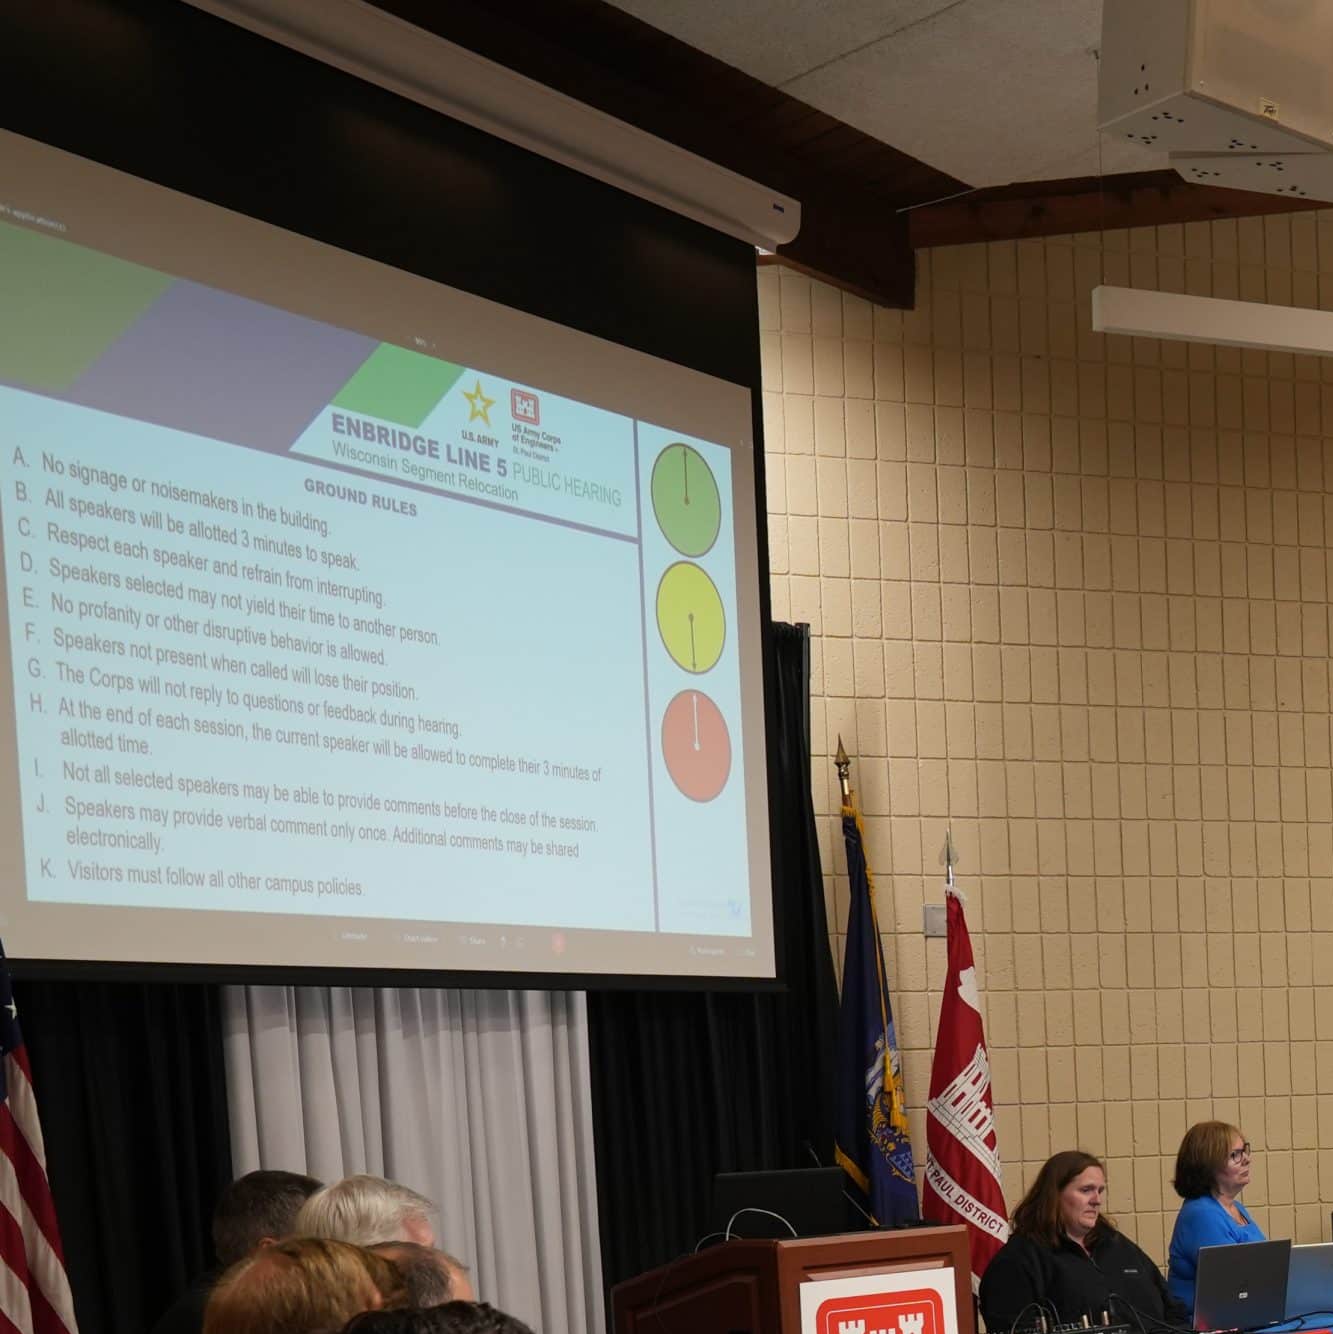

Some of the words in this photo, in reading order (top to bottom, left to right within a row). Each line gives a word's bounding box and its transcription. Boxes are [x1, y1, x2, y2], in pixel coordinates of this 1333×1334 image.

[331, 412, 440, 460] ENBRIDGE
[445, 443, 491, 473] LINE
[496, 457, 508, 478] 5
[511, 461, 561, 491] PUBLIC
[563, 474, 622, 508] HEARING
[331, 439, 398, 472] Wisconsin
[400, 457, 456, 488] Segment
[457, 471, 519, 503] Relocation
[477, 434, 500, 448] ARMY
[42, 450, 64, 475] No
[69, 459, 127, 492] signage
[131, 477, 146, 493] or
[151, 479, 238, 514] noisemakers
[241, 496, 253, 519] in
[256, 501, 277, 523] the
[303, 477, 367, 505] GROUND
[371, 493, 418, 517] RULES
[44, 487, 64, 509] All
[69, 496, 136, 525] speakers
[139, 510, 163, 531] will
[166, 512, 184, 535] be
[188, 519, 238, 545] allotted
[240, 528, 250, 548] 3
[252, 533, 302, 559] minutes
[305, 543, 318, 562] to
[47, 521, 110, 553] Respect
[113, 539, 149, 561] each
[152, 545, 208, 572] speaker
[212, 559, 238, 578] and
[241, 562, 282, 587] refrain
[285, 569, 313, 592] from
[49, 556, 121, 589] Speakers
[125, 573, 184, 600] selected
[187, 586, 216, 610] may
[220, 592, 242, 611] not
[245, 594, 275, 616] yield
[278, 599, 306, 622] their
[309, 605, 335, 627] time
[338, 611, 350, 630] to
[352, 617, 396, 639] another
[50, 591, 74, 615] No
[78, 600, 141, 630] profanity
[145, 612, 159, 629] or
[163, 612, 198, 635] other
[202, 618, 266, 648] disruptive
[270, 628, 323, 656] behavior
[326, 639, 336, 658] is
[53, 626, 125, 656] Speakers
[129, 641, 152, 661] not
[155, 647, 207, 670] present
[210, 652, 247, 675] when
[249, 659, 288, 681] called
[291, 665, 311, 685] will
[313, 667, 339, 689] lose
[341, 672, 368, 693] their
[56, 660, 84, 685] The
[89, 666, 134, 694] Corps
[138, 675, 160, 696] will
[164, 679, 186, 699] not
[189, 683, 222, 708] reply
[226, 687, 239, 706] to
[242, 692, 304, 715] questions
[307, 701, 319, 717] or
[322, 699, 376, 725] feedback
[379, 708, 415, 734] during
[58, 696, 74, 718] At
[78, 698, 101, 721] the
[105, 703, 133, 725] end
[137, 707, 152, 727] of
[155, 711, 190, 732] each
[251, 721, 272, 742] the
[275, 728, 319, 748] current
[322, 734, 369, 753] speaker
[372, 738, 390, 757] will
[393, 739, 408, 759] be
[411, 743, 453, 764] allowed
[455, 748, 466, 766] to
[468, 753, 515, 775] complete
[518, 757, 540, 775] their
[543, 759, 549, 776] 3
[552, 762, 589, 781] minutes
[591, 767, 602, 782] of
[60, 727, 114, 751] allotted
[63, 759, 90, 783] Not
[93, 764, 110, 784] all
[114, 767, 173, 791] selected
[177, 775, 239, 799] speakers
[242, 783, 269, 805] may
[273, 783, 289, 802] be
[292, 785, 319, 805] able
[322, 788, 334, 807] to
[337, 792, 381, 812] provide
[383, 798, 441, 817] comments
[443, 799, 478, 821] before
[480, 805, 497, 823] the
[499, 807, 526, 825] close
[529, 809, 539, 827] of
[541, 811, 556, 828] the
[67, 859, 123, 883] Visitors
[126, 866, 162, 885] must
[165, 865, 205, 887] follow
[208, 869, 224, 888] all
[227, 871, 262, 890] other
[264, 877, 314, 896] campus
[930, 1169, 955, 1198] PAUL
[955, 1194, 1004, 1233] DISTRICT
